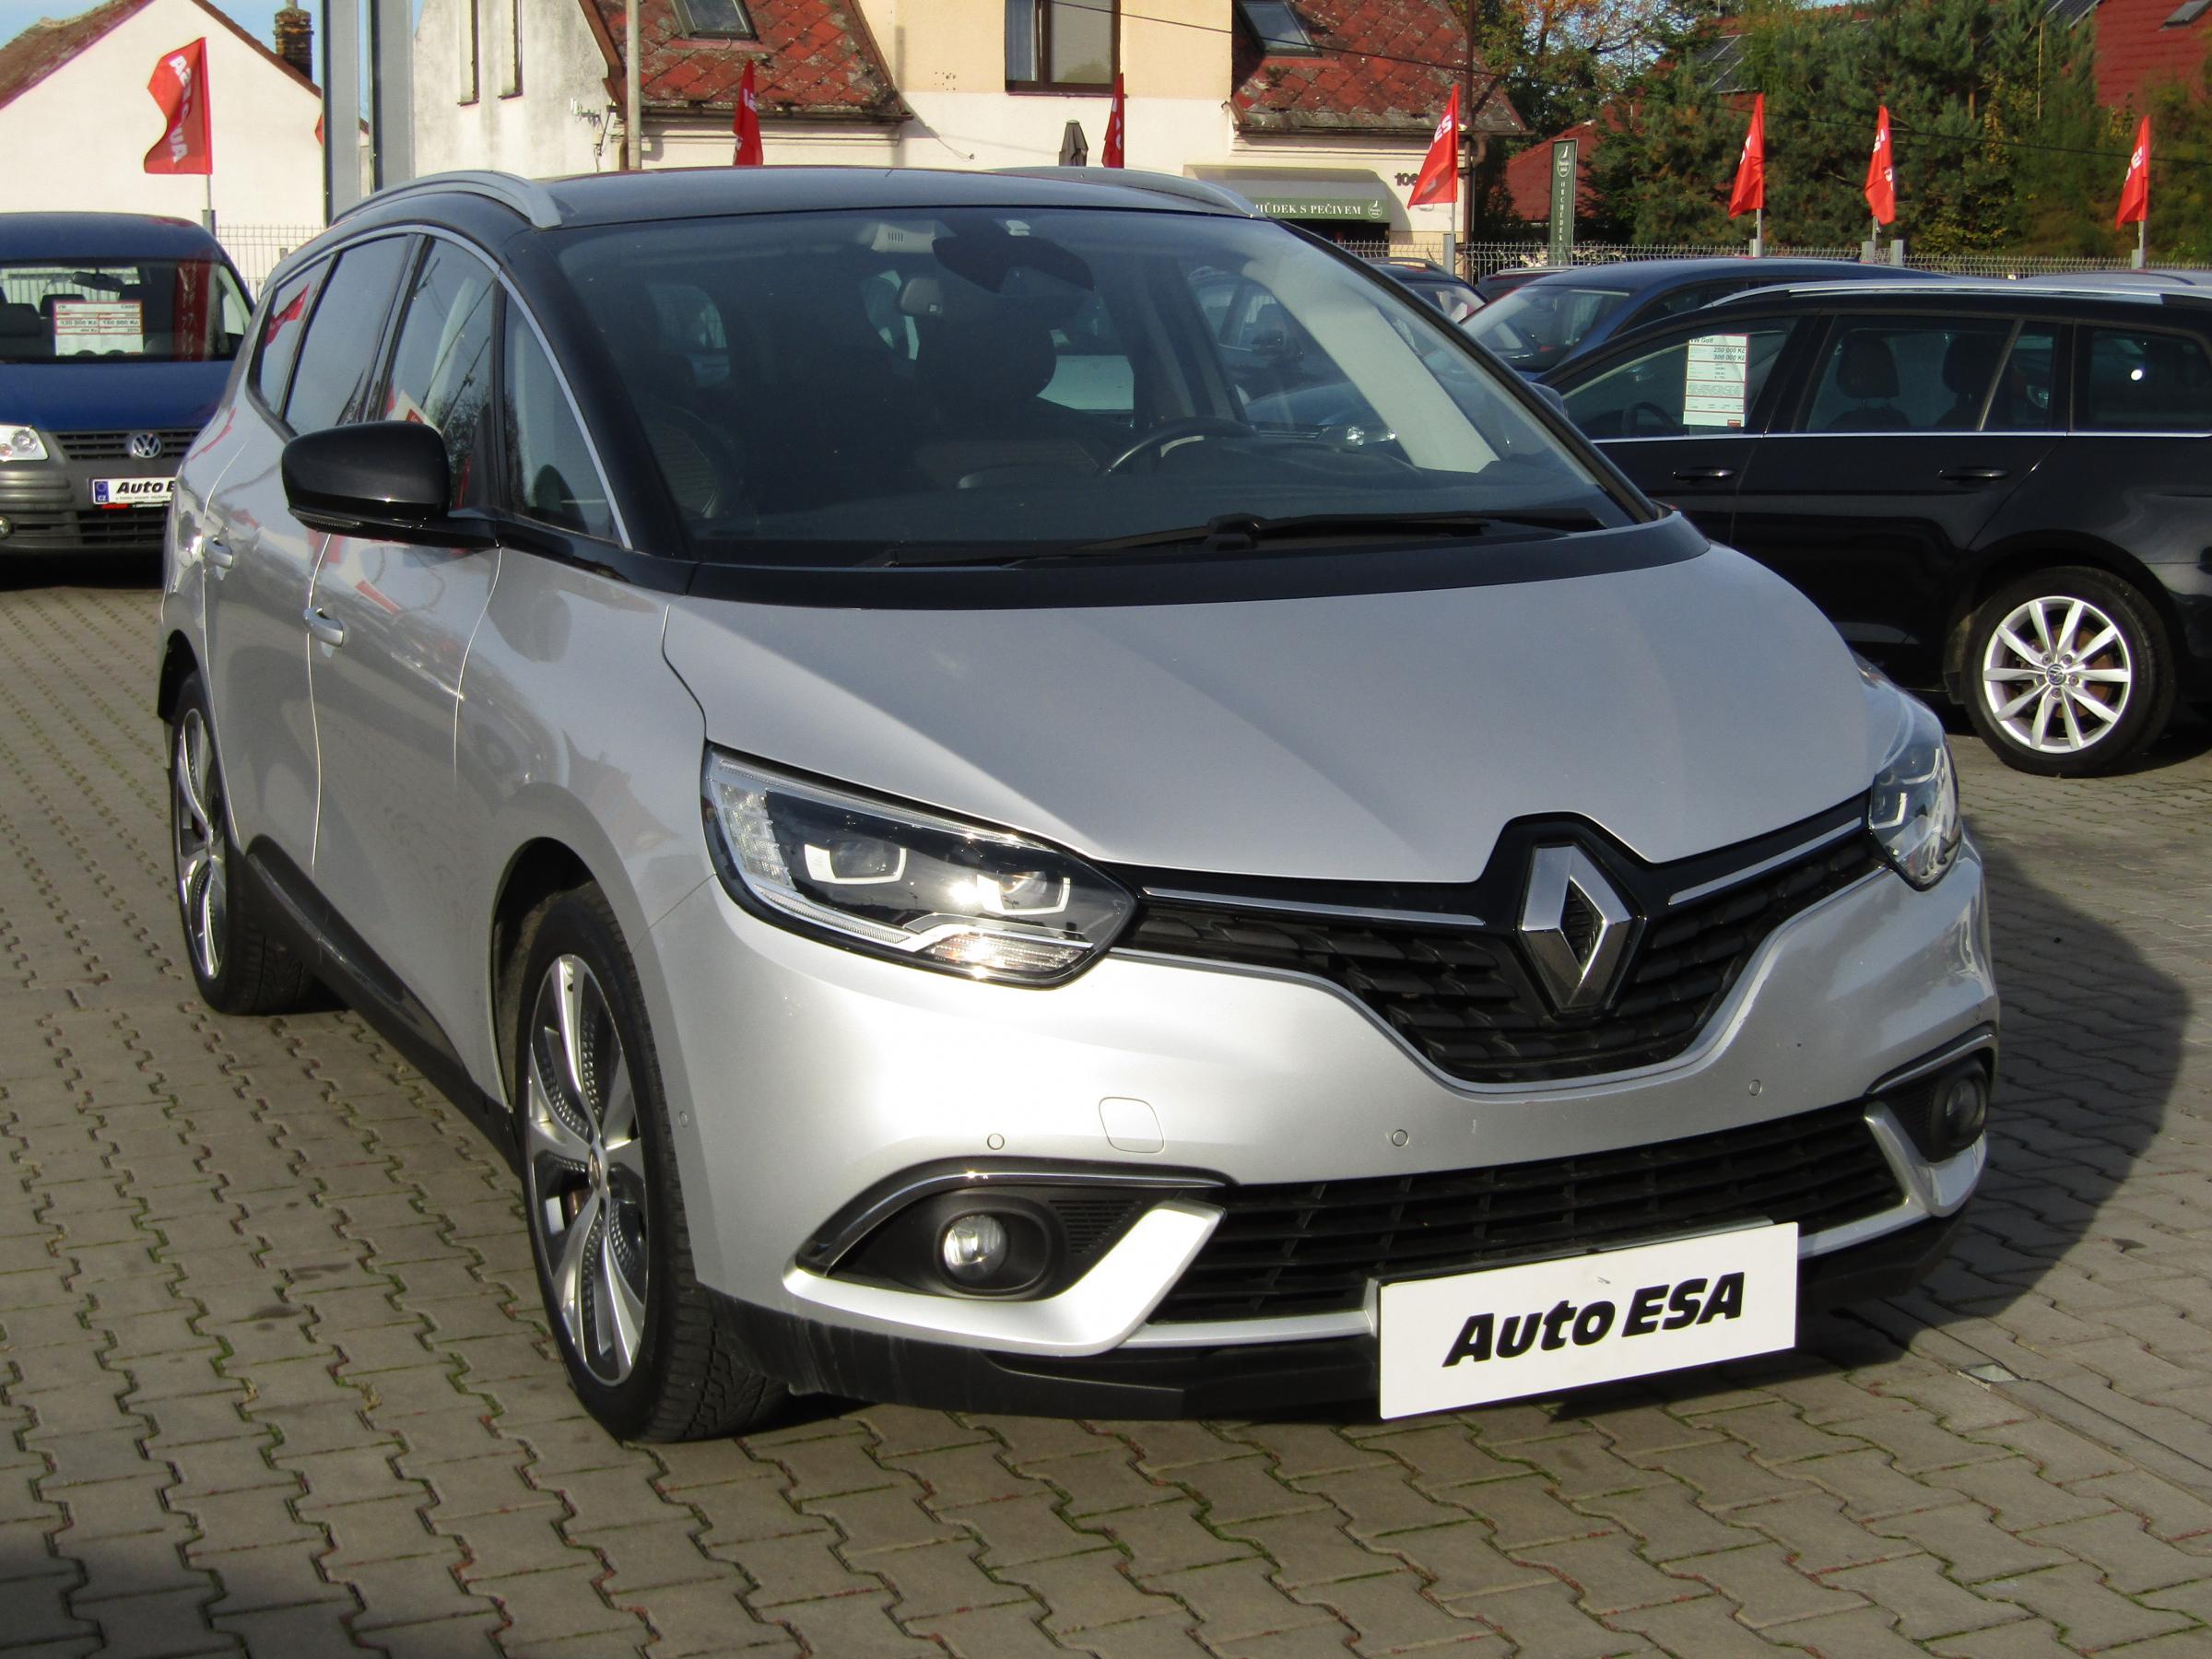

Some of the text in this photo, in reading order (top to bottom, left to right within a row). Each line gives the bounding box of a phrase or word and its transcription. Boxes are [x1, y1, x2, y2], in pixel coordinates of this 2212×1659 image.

[1300, 205, 1307, 214] S
[1310, 203, 1361, 215] PEČIVEM
[116, 481, 164, 493] Auto
[1442, 1271, 1745, 1367] Auto ESA
